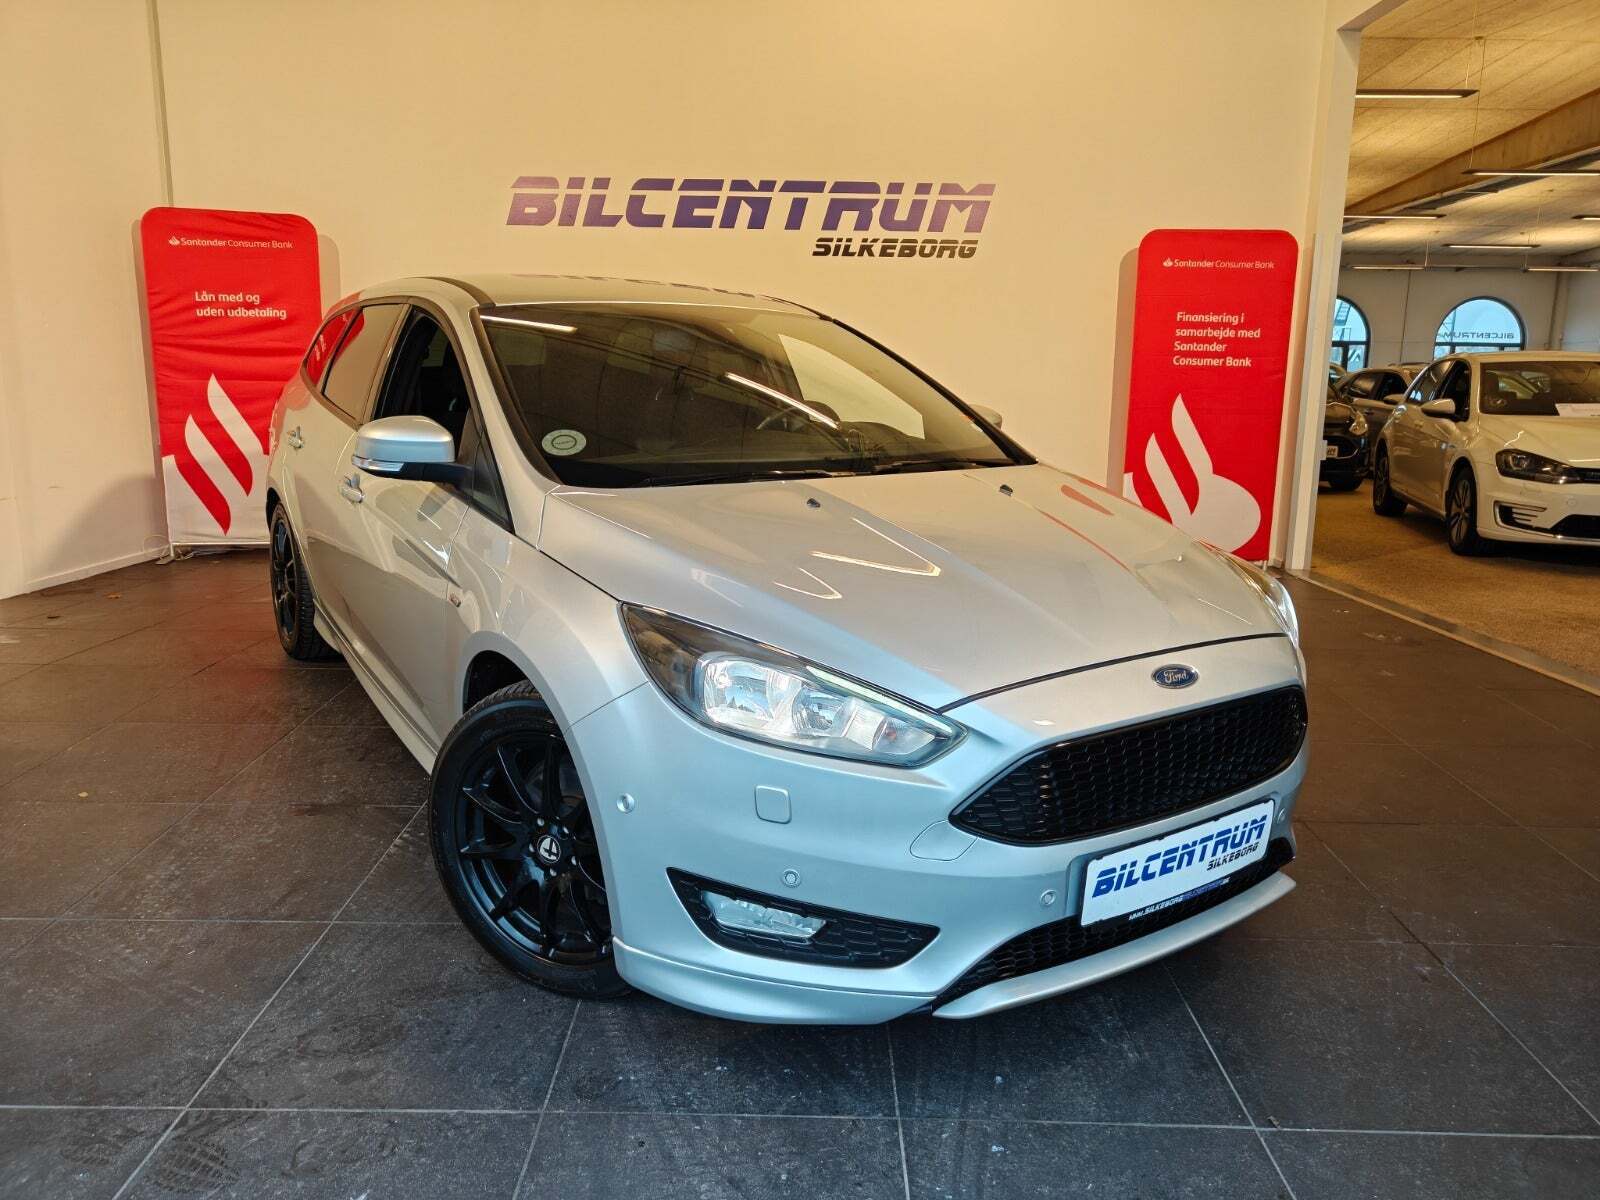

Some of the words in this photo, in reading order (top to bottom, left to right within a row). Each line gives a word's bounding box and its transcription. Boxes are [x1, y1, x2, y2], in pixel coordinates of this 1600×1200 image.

[505, 175, 996, 233] BILCENTRUM
[181, 237, 227, 247] Santander
[227, 239, 271, 249] Consumer
[272, 240, 293, 249] Bank
[812, 237, 978, 259] SILKEBORG
[1174, 259, 1214, 268] Santander
[1215, 260, 1254, 269] Consumer
[1255, 261, 1275, 269] Bank
[195, 291, 216, 302] Lån
[218, 292, 243, 302] med
[246, 294, 260, 305] og
[196, 307, 225, 318] uden
[227, 307, 287, 320] udbetaling
[1176, 312, 1239, 326] Finansiering
[1240, 313, 1244, 323] i
[1175, 327, 1236, 340] samarbejde
[1238, 328, 1261, 338] med
[1174, 341, 1227, 352] Santander
[1173, 355, 1223, 366] Consumer
[1225, 356, 1252, 367] Bank
[1163, 669, 1189, 684] Ford
[1092, 814, 1267, 898] BILCENTRUM
[1206, 841, 1259, 871] SILKEBORG
